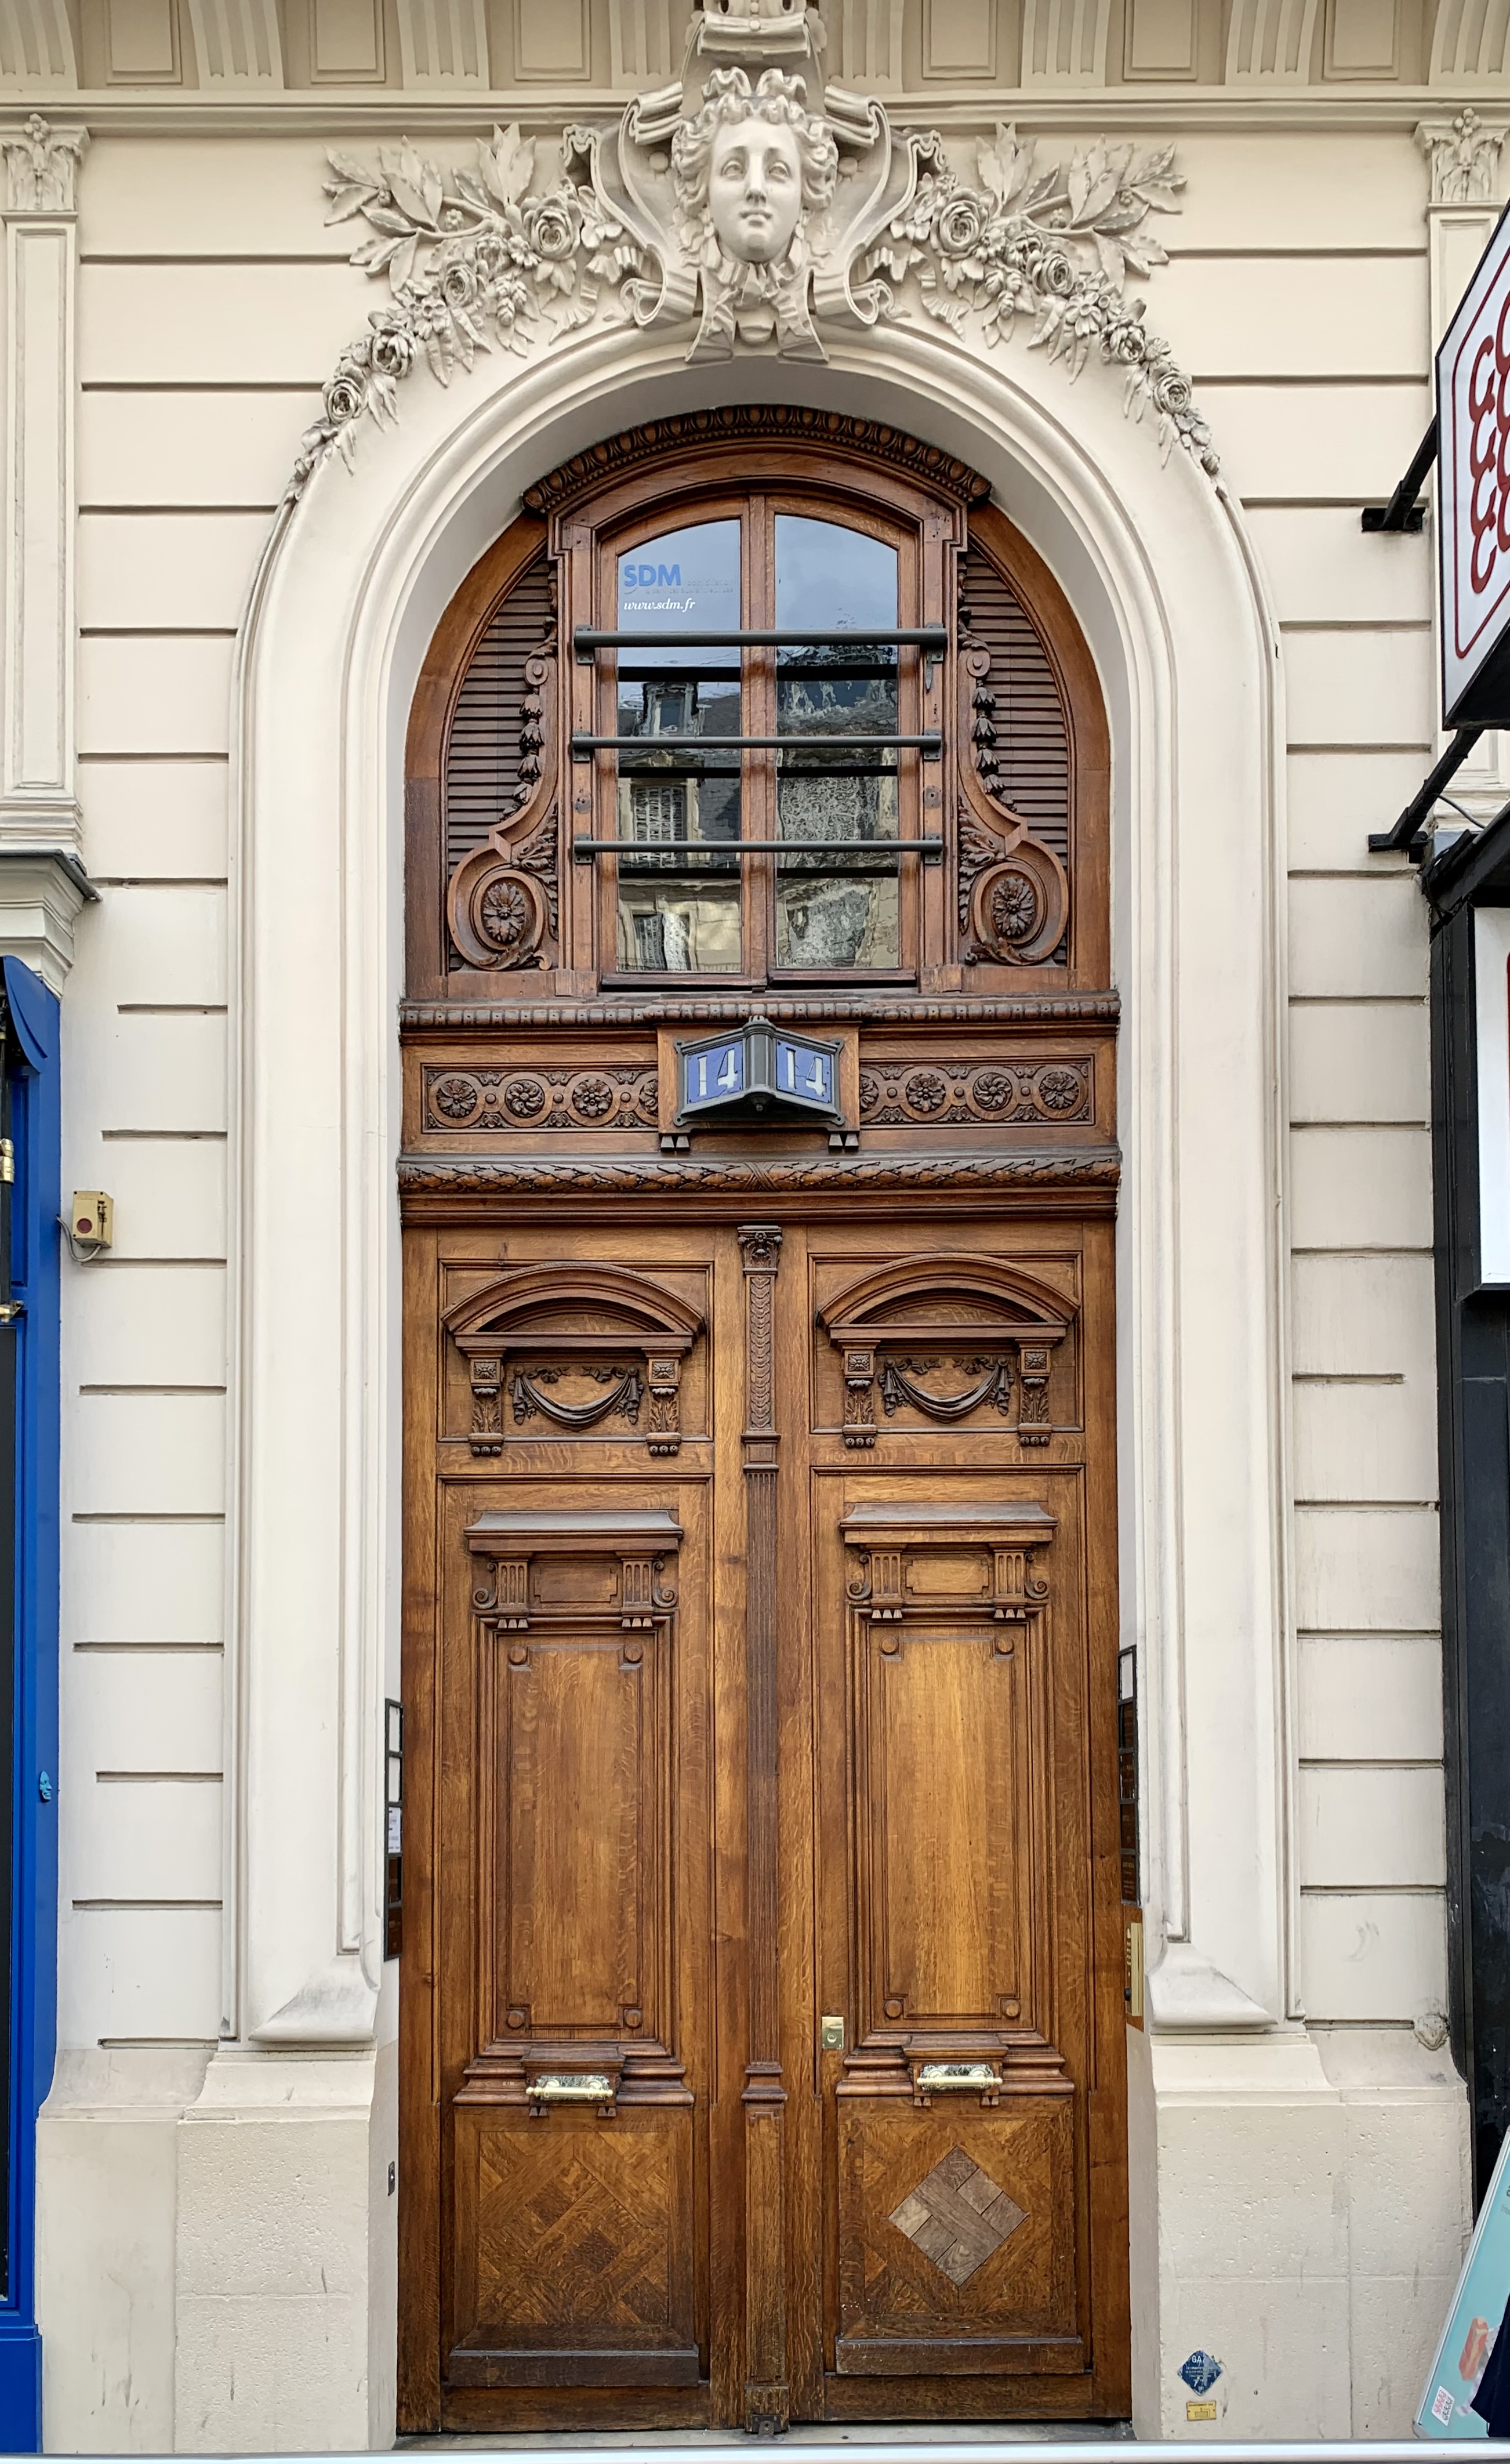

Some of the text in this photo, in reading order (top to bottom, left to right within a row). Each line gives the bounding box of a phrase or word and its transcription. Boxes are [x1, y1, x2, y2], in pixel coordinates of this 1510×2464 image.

[624, 564, 681, 586] SDM
[624, 597, 696, 613] www.sdm.fr
[698, 1048, 738, 1097] 14
[786, 1048, 827, 1096] 14
